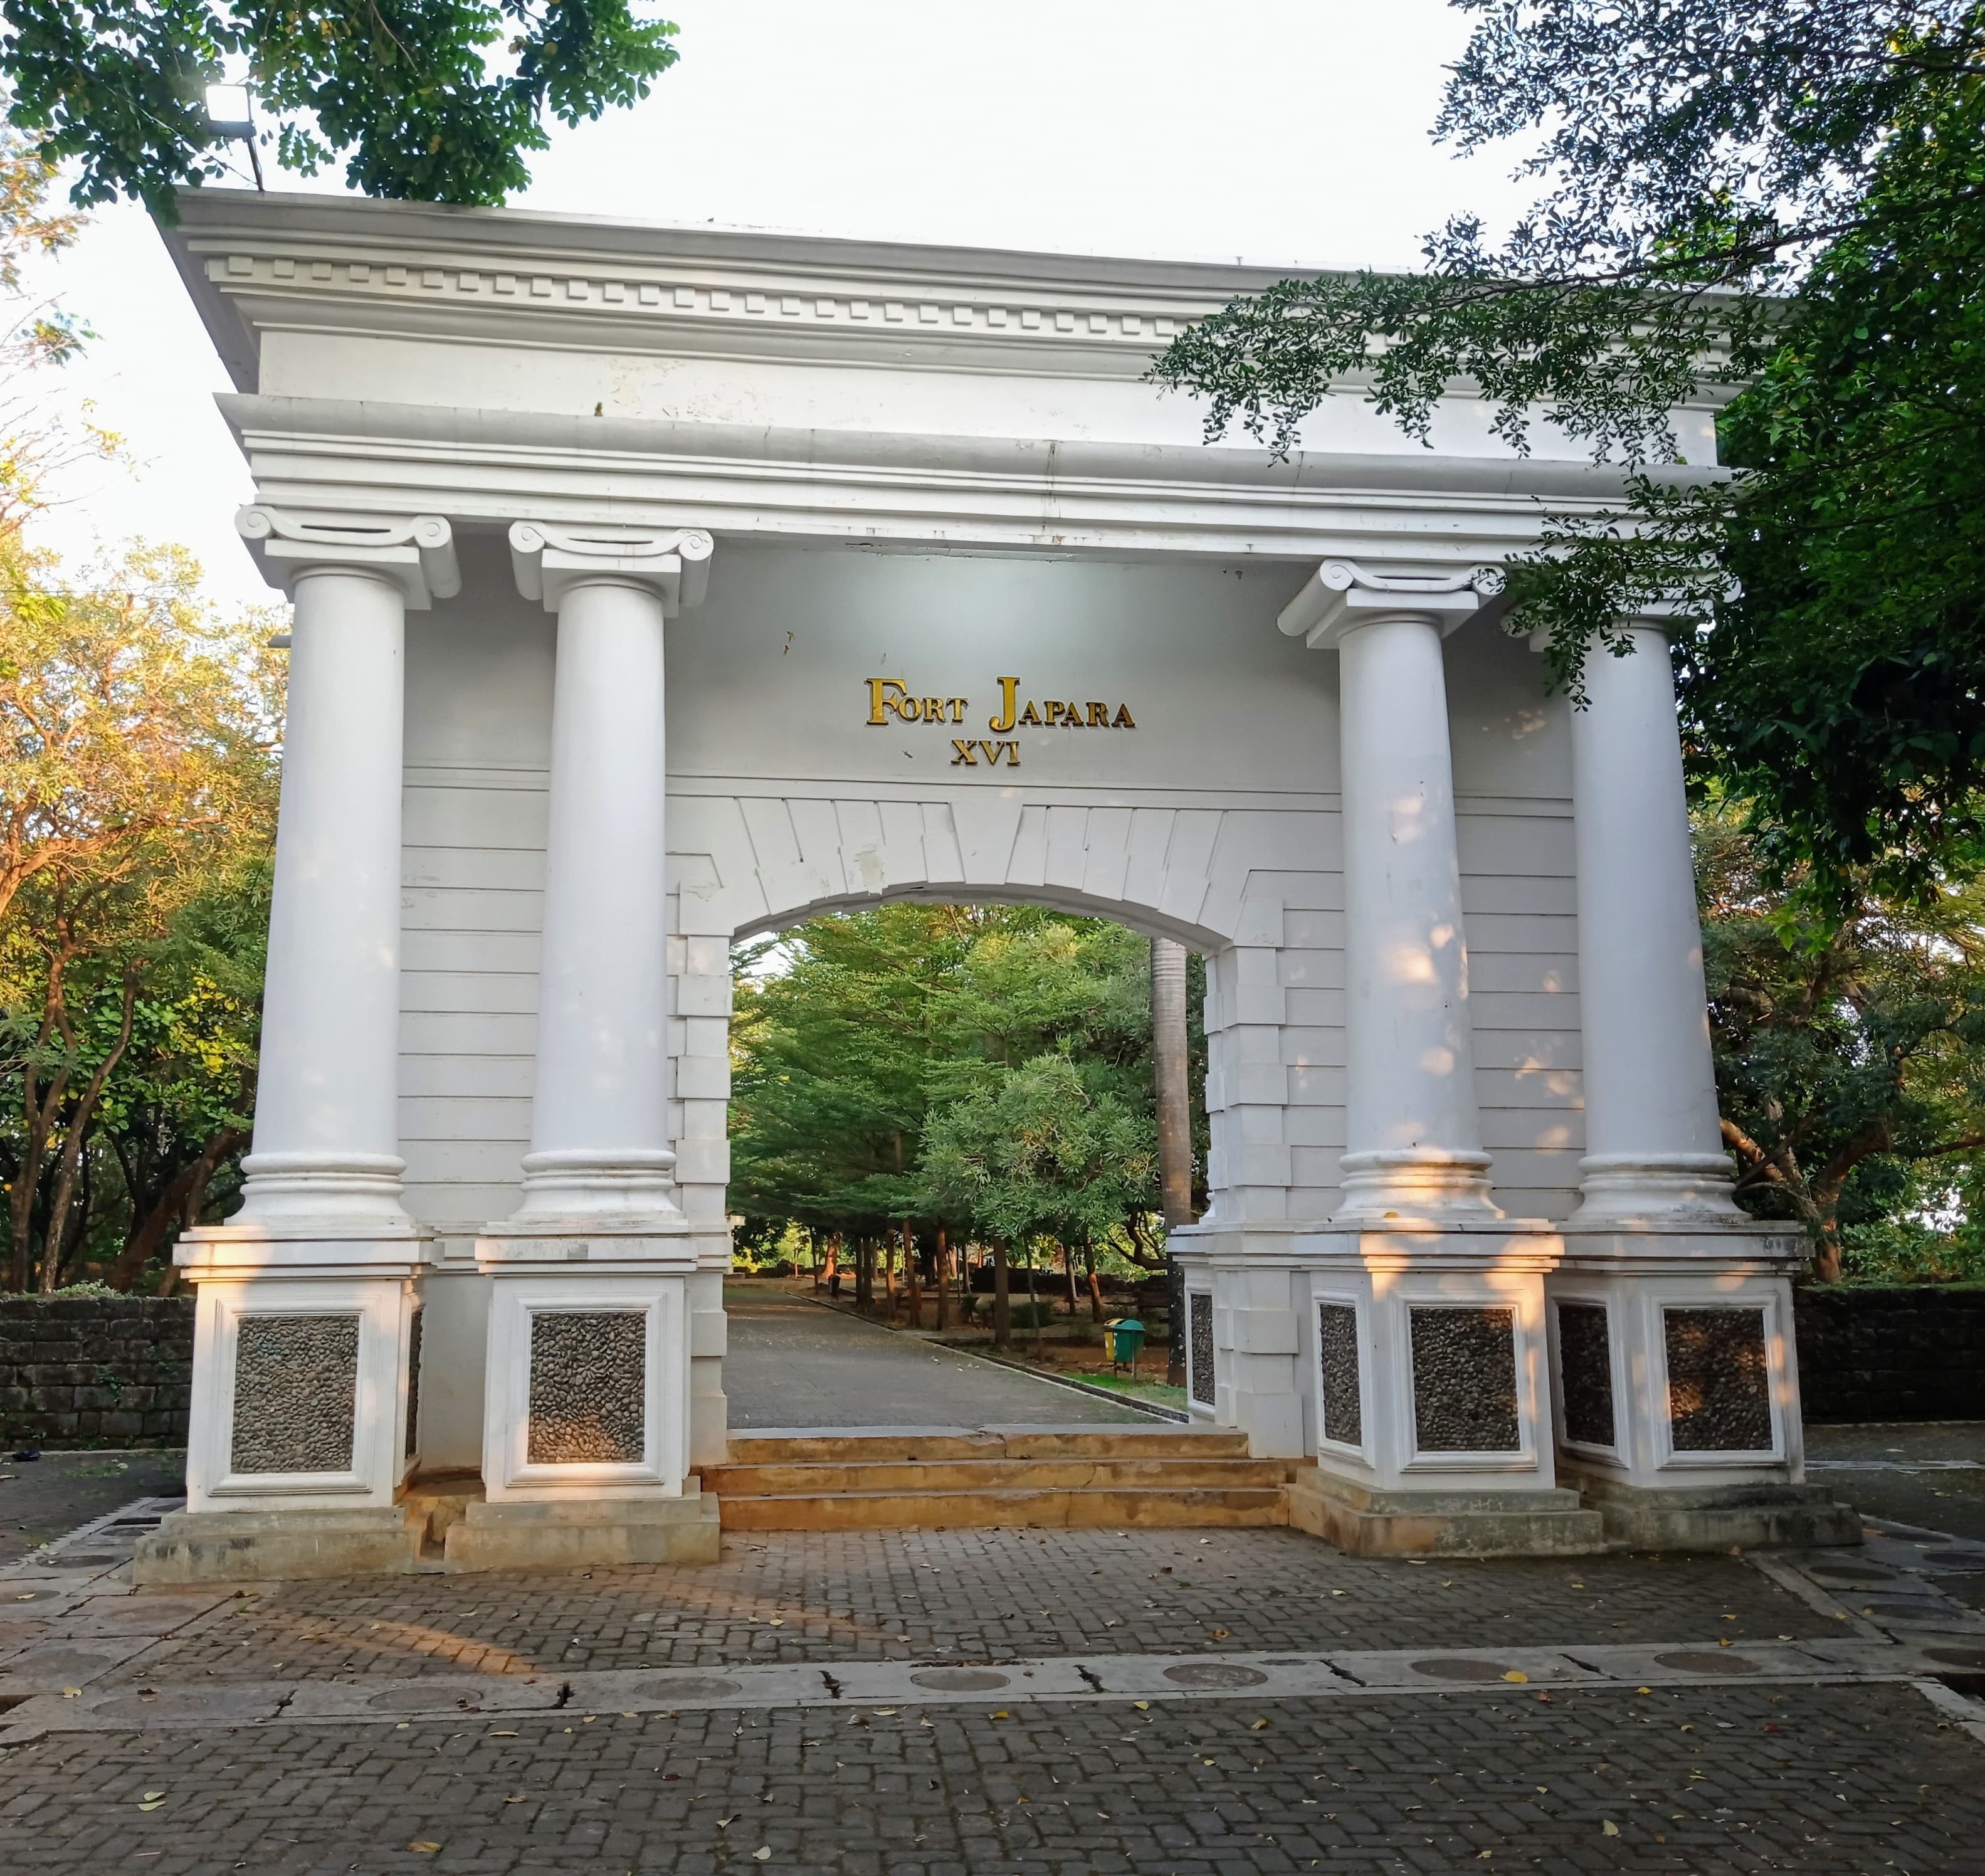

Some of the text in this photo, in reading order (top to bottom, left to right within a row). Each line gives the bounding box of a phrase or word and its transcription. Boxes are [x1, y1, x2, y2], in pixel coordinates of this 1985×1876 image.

[865, 677, 1136, 732] FORT JAPARA
[951, 739, 1021, 766] XVI
